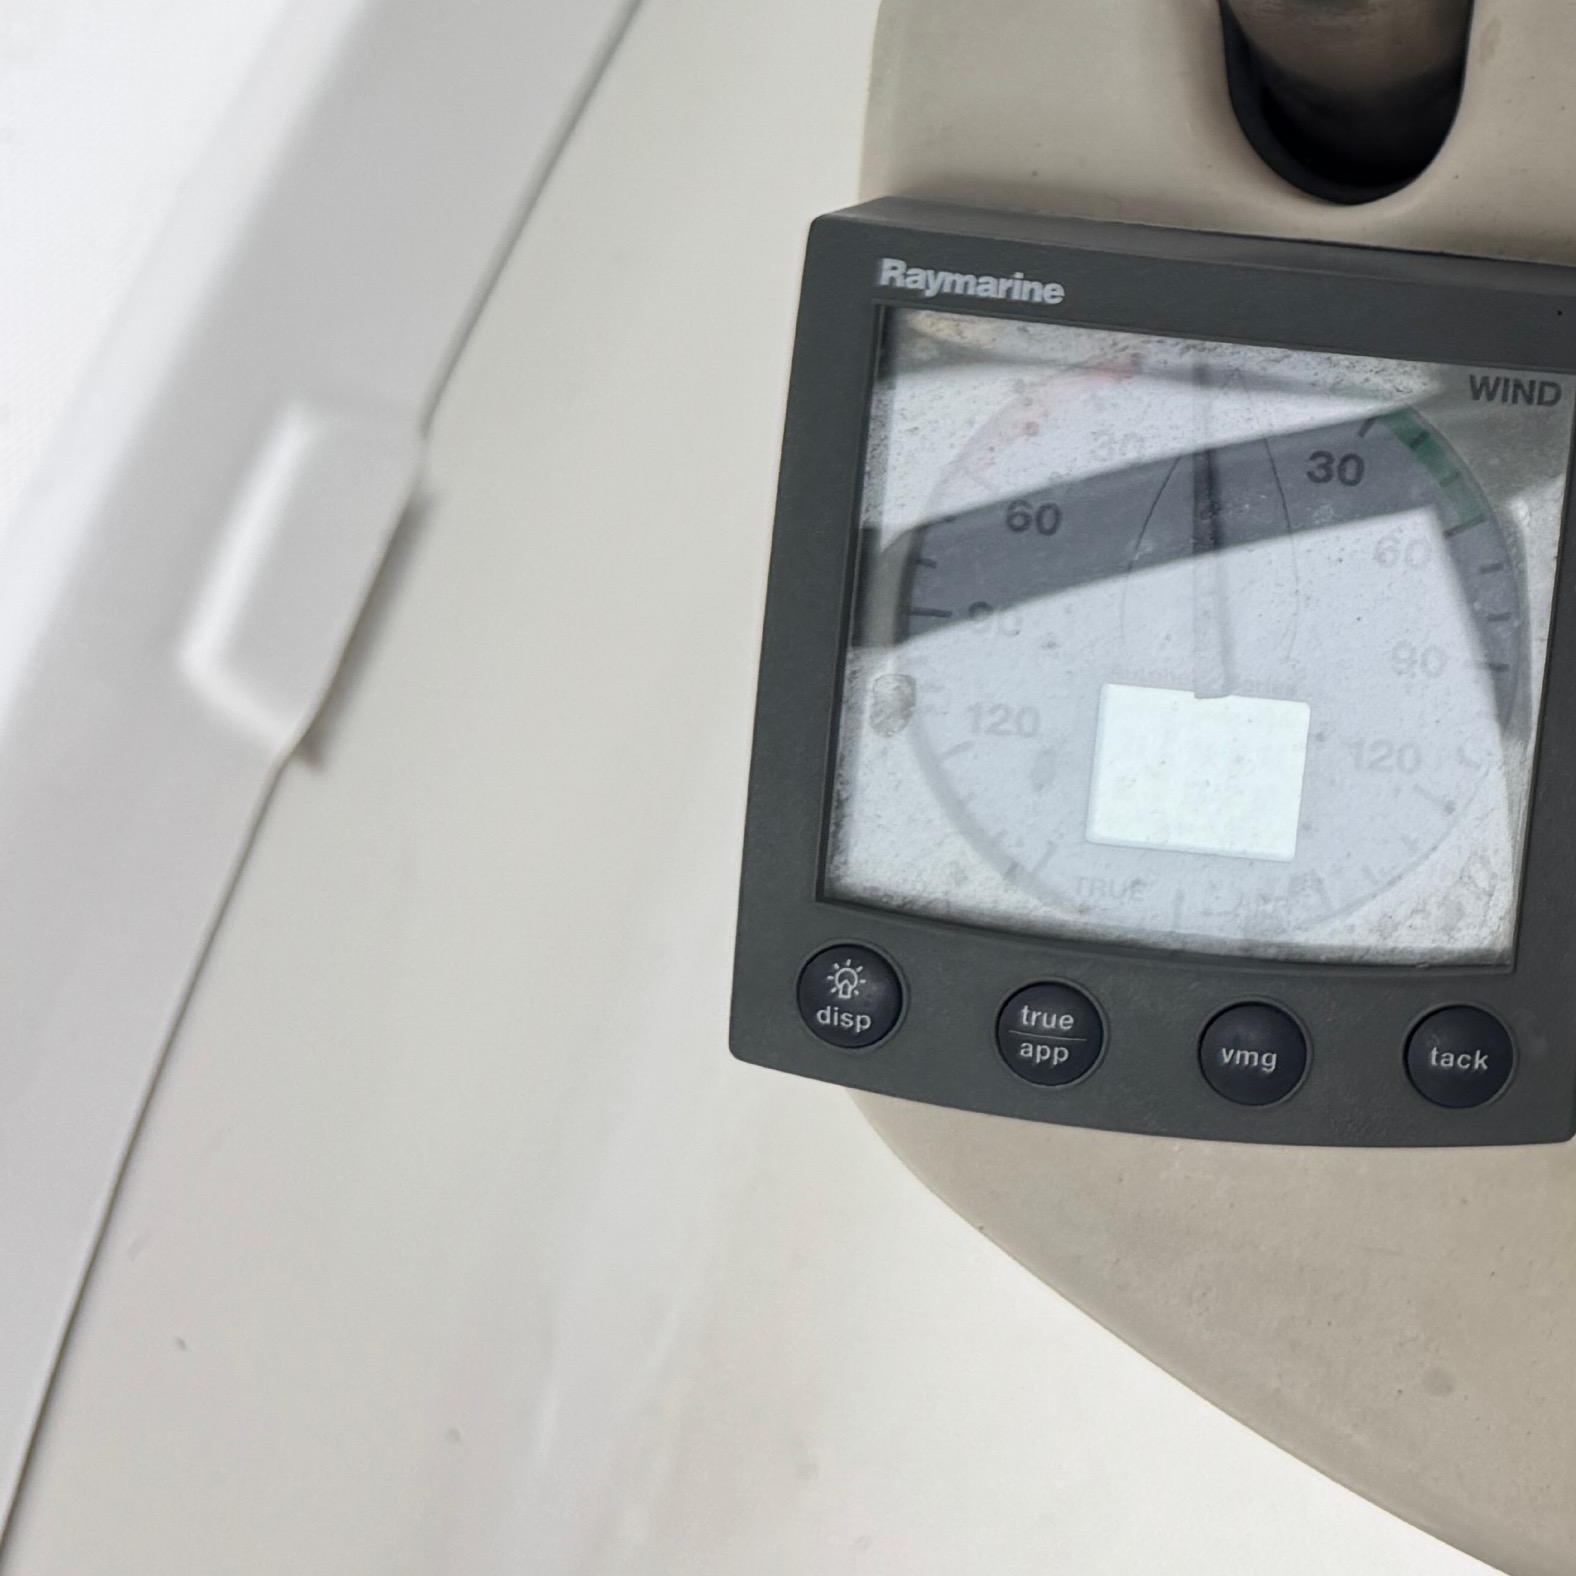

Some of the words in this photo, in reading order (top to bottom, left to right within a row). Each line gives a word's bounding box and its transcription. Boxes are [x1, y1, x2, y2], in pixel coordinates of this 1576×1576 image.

[877, 257, 1066, 306] Raymarine
[1467, 372, 1563, 410] WIND
[1306, 450, 1365, 487] 30
[1006, 499, 1062, 536] 60
[968, 703, 1040, 739] 120
[816, 1005, 872, 1034] disp
[1020, 1002, 1075, 1032] true
[1018, 1040, 1070, 1068] app
[1220, 1046, 1278, 1074] vmg
[1428, 1044, 1490, 1072] tack
